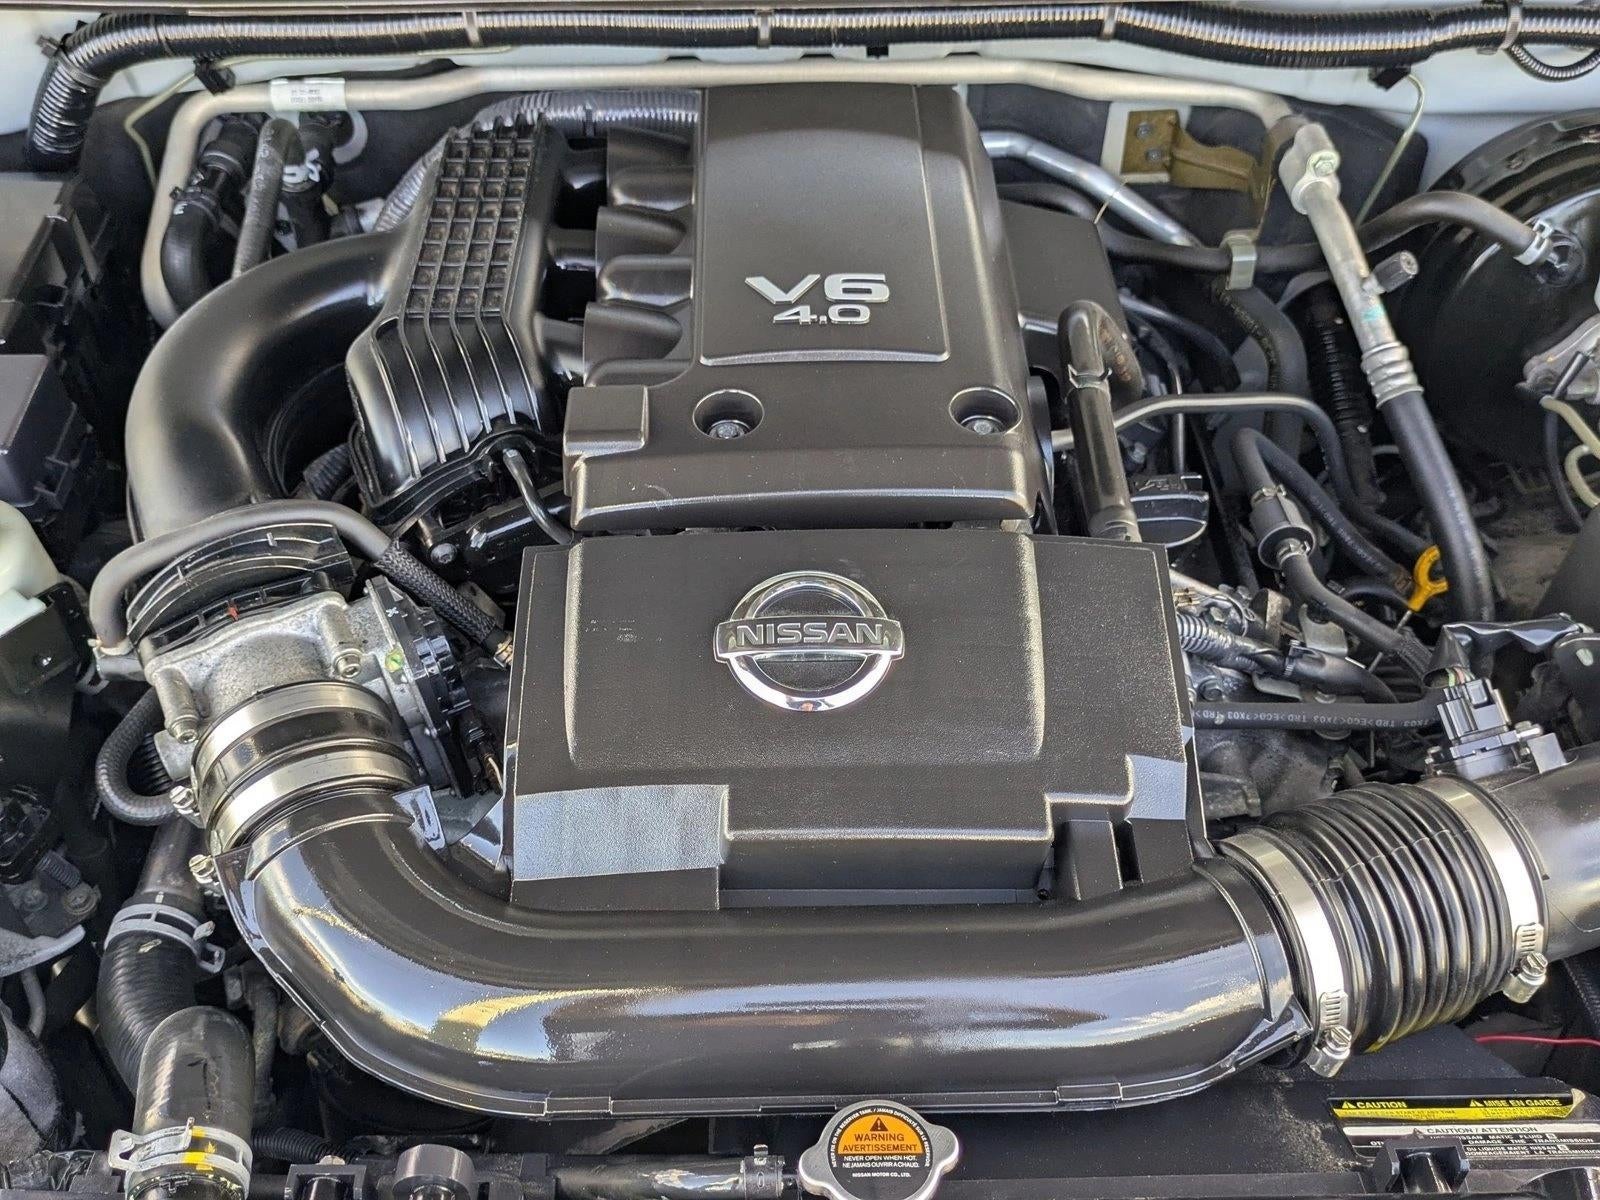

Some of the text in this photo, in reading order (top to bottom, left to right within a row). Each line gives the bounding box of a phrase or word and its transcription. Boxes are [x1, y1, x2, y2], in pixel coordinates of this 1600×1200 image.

[745, 273, 890, 303] V6
[773, 304, 870, 324] 4.0
[736, 622, 883, 645] NISSAN
[1356, 1101, 1407, 1109] CAUTION
[854, 1133, 904, 1141] WARNING
[843, 1144, 917, 1152] AVERTISSEMENT
